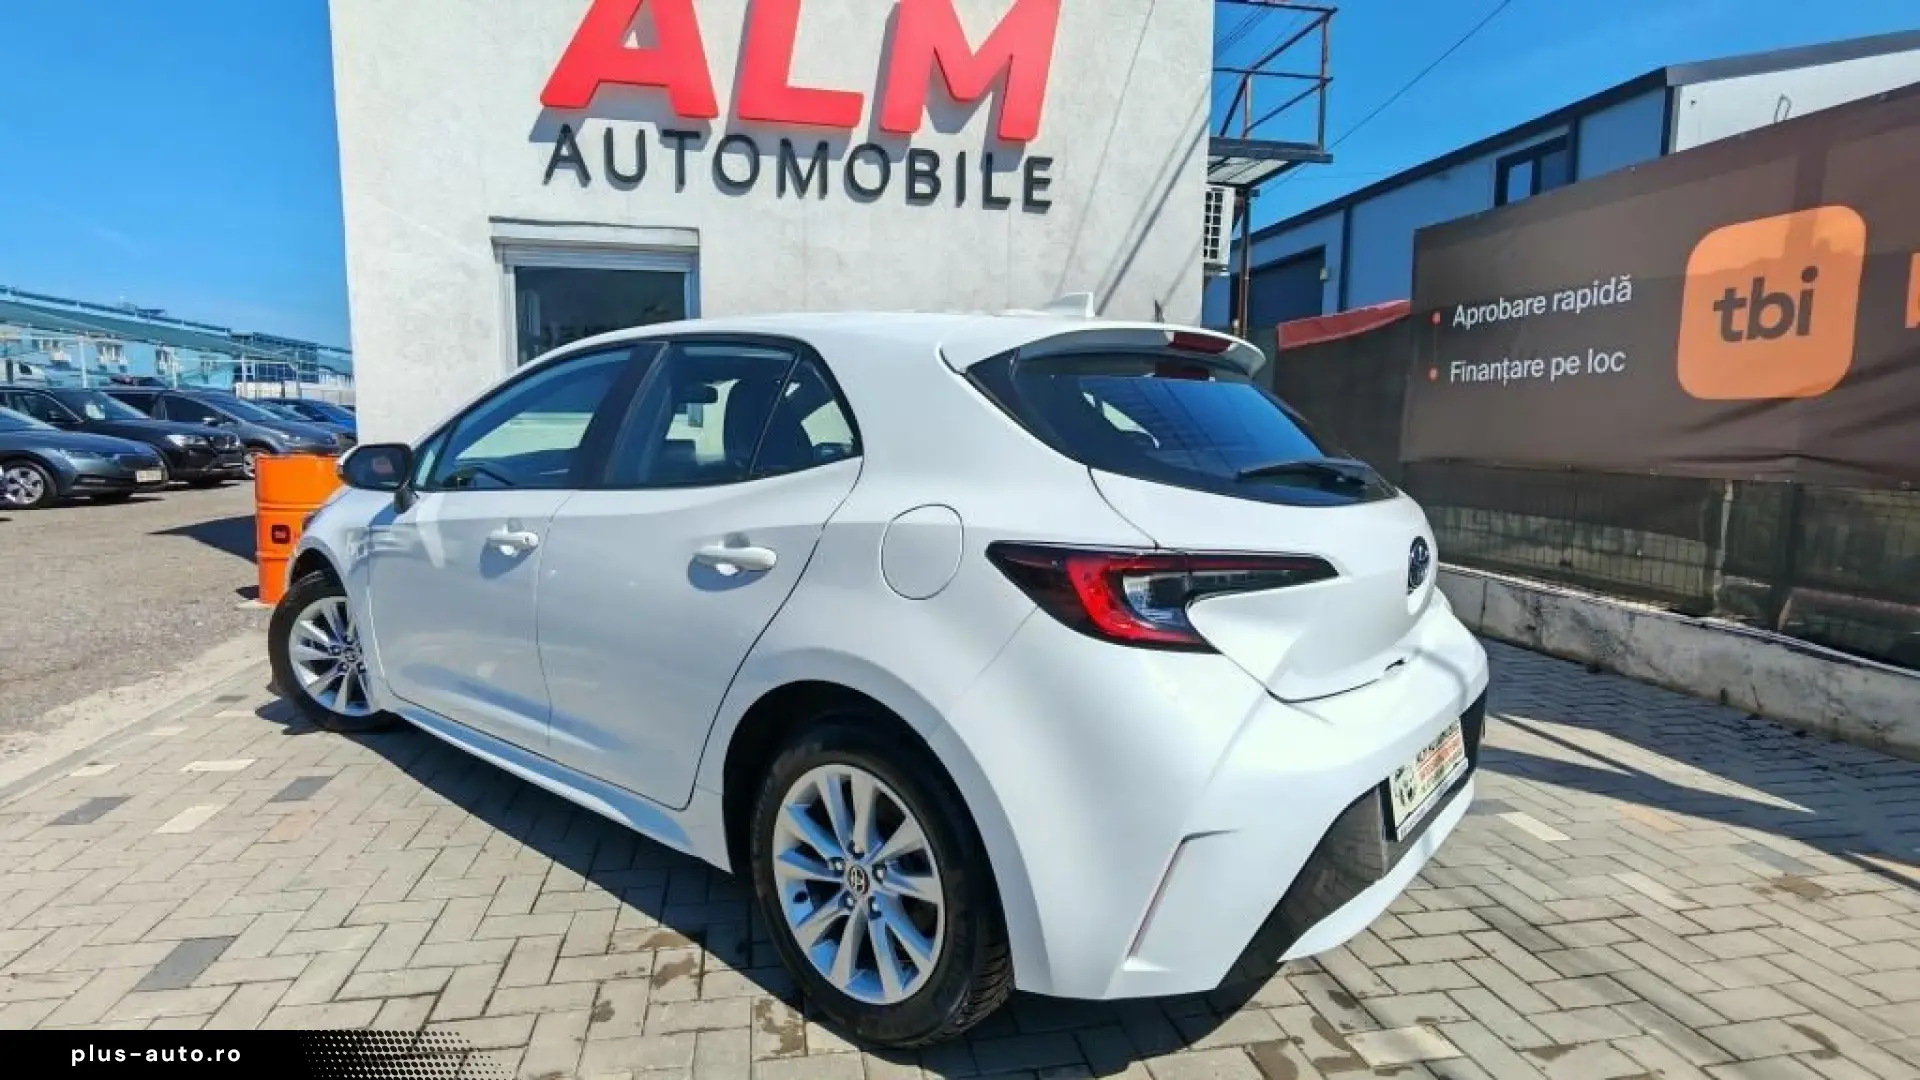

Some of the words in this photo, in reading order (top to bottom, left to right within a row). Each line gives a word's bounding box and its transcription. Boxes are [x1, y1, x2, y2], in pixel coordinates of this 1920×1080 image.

[540, 0, 1060, 141] ALM
[544, 124, 1053, 210] AUTOMOBILE
[1453, 296, 1546, 330] Aprobare
[1552, 274, 1633, 314] rapidă
[1713, 265, 1818, 342] tbi
[1450, 357, 1545, 387] Finanțare
[1551, 355, 1581, 382] pe
[1587, 348, 1627, 374] loc
